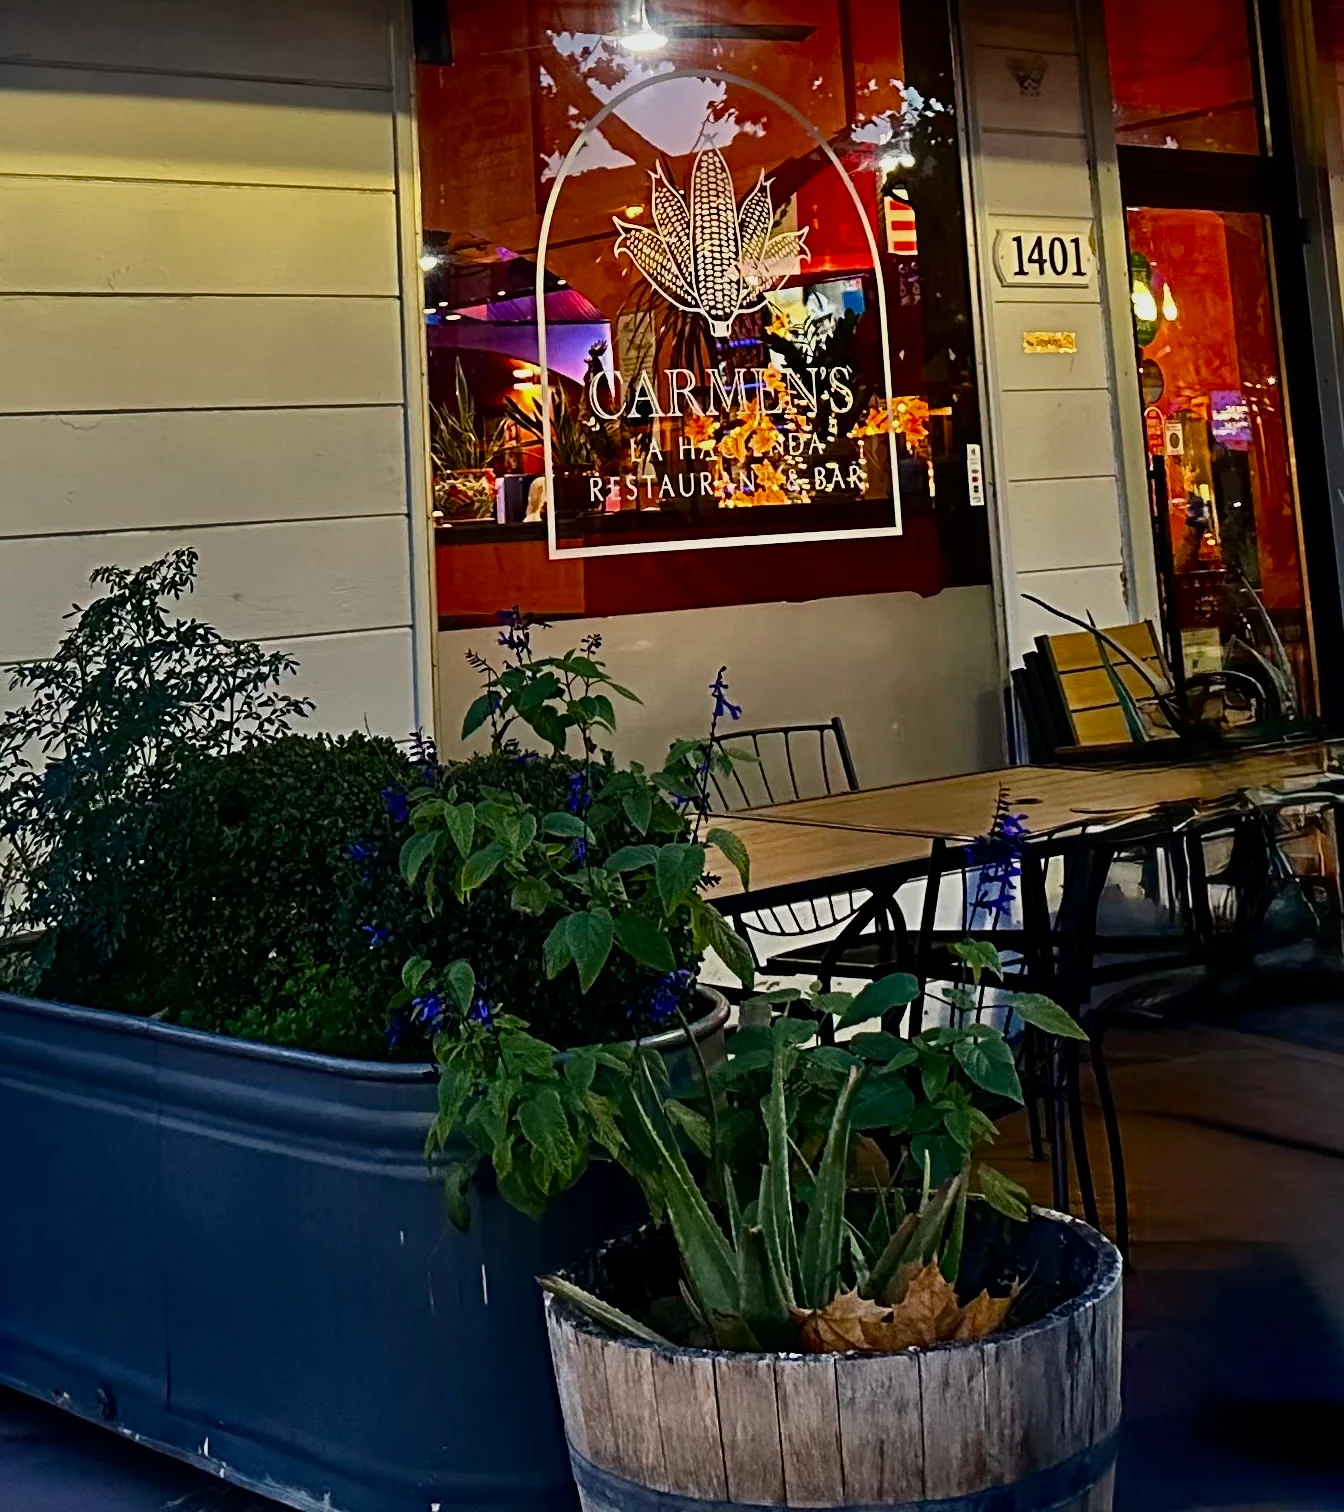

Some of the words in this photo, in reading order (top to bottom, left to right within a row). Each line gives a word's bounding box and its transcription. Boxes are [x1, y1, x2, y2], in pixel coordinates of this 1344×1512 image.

[1012, 236, 1087, 276] 1401
[588, 365, 854, 420] CARMEN'S
[630, 436, 663, 462] LA
[814, 464, 863, 492] BAR
